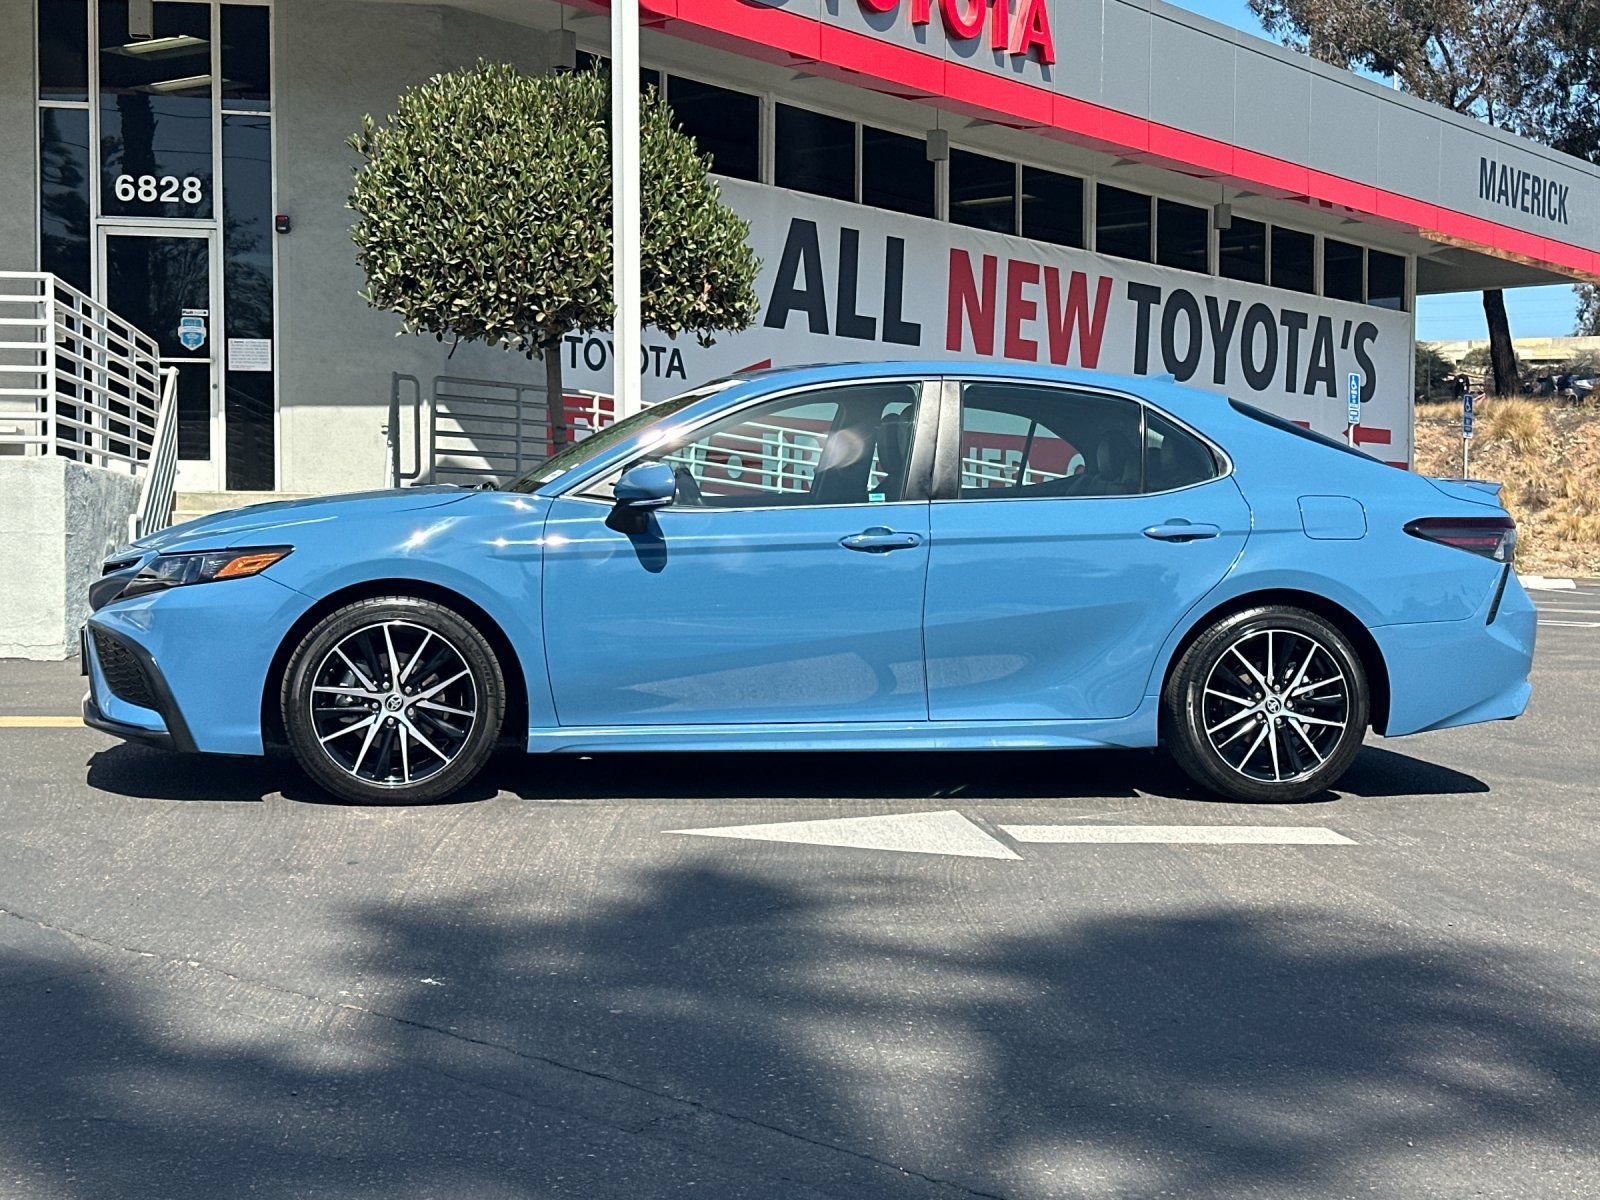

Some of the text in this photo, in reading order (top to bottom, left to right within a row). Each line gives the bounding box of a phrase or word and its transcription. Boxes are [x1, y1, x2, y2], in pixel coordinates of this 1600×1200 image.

[115, 174, 202, 204] 6828
[1479, 157, 1569, 225] MAVERICK
[763, 217, 1378, 403] ALL NEW TOYOTA'S
[564, 335, 687, 380] TOTA
